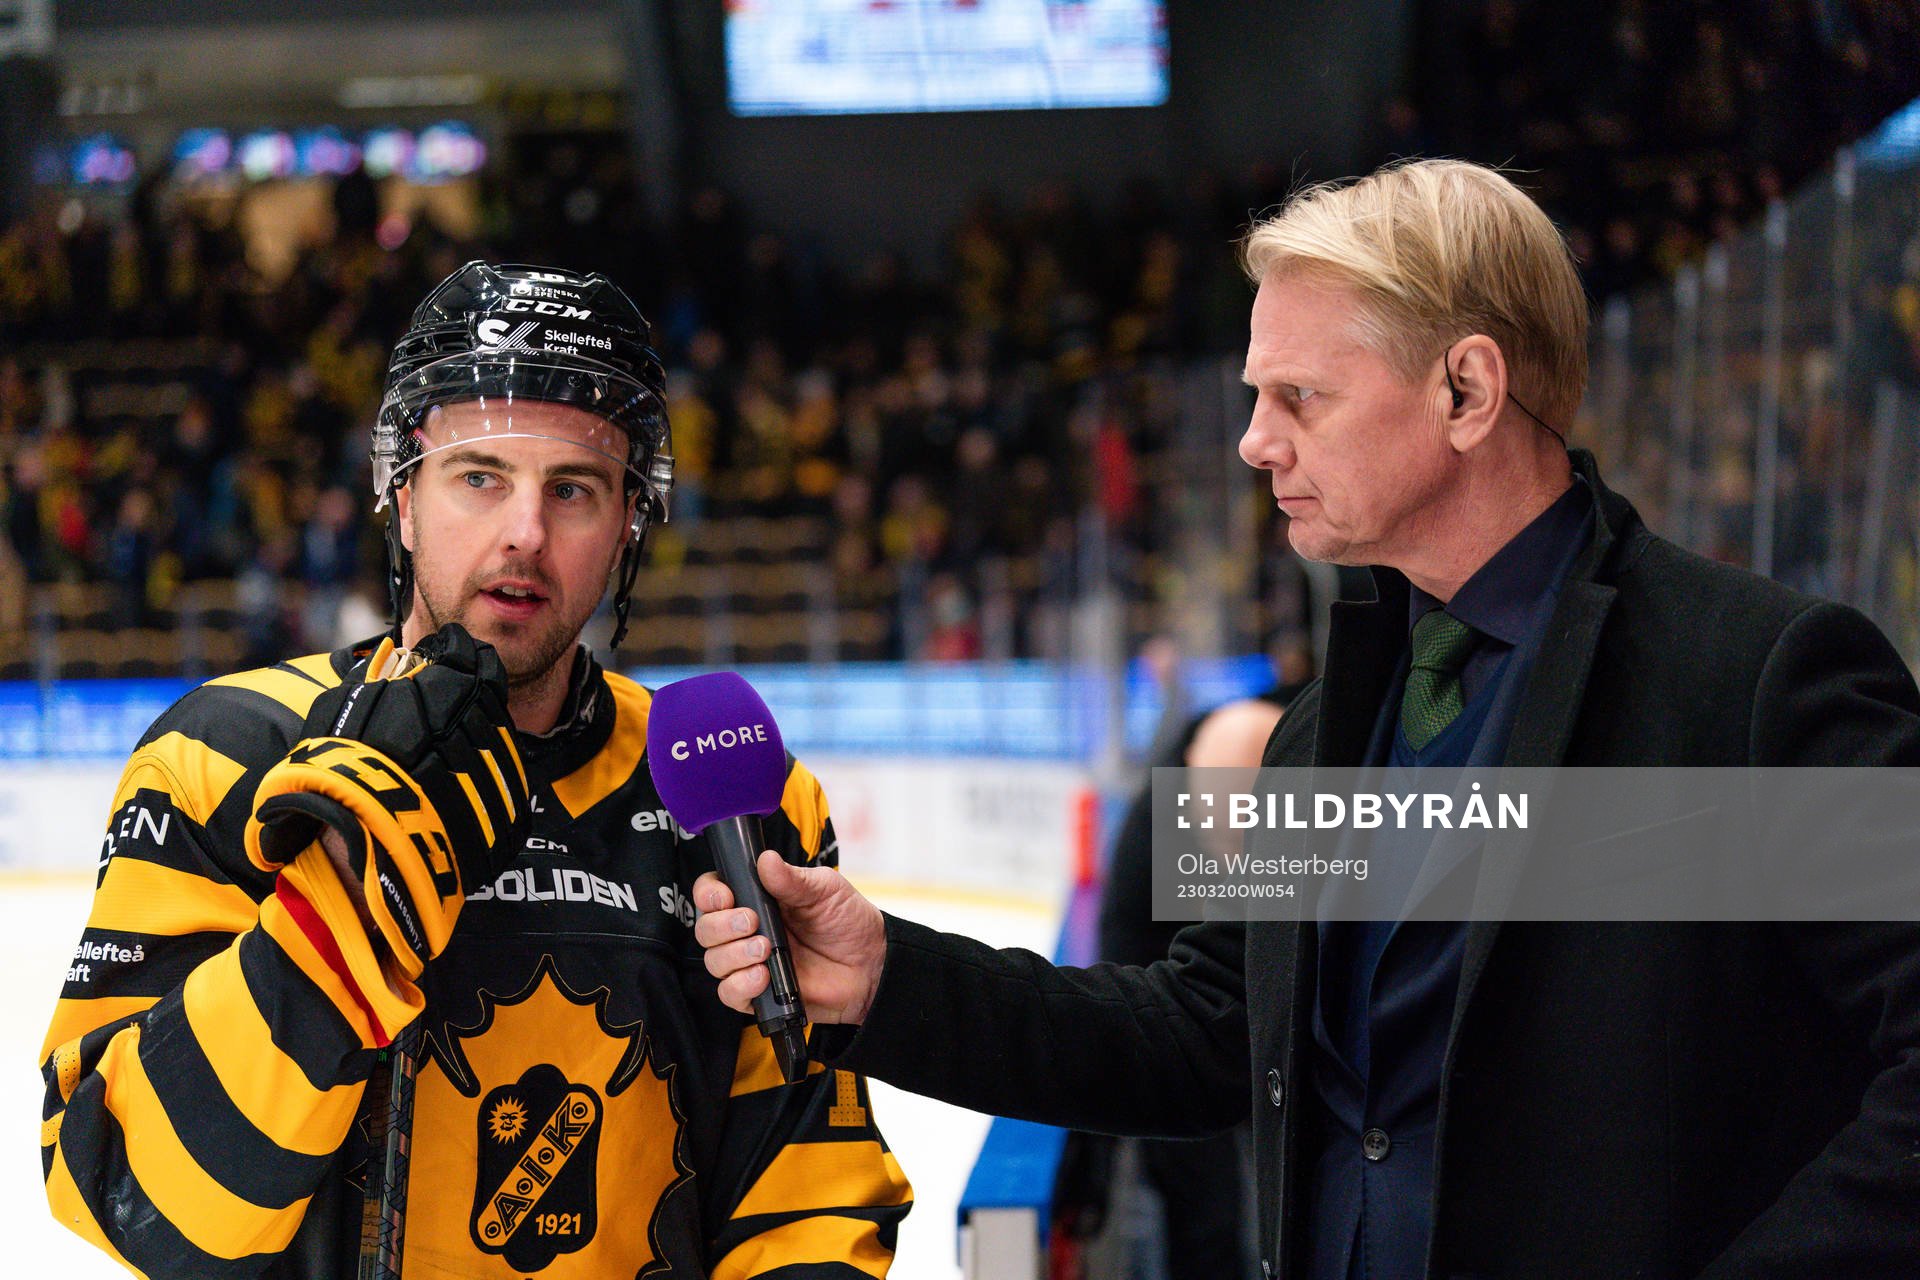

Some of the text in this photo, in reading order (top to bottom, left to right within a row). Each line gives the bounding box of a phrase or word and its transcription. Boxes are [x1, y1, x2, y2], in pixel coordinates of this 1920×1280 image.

[535, 286, 581, 300] SVENSKA
[535, 291, 560, 300] SPEL
[505, 298, 592, 321] CCM
[544, 329, 612, 351] Skellefteå
[671, 724, 768, 761] C MORE
[525, 837, 569, 853] CM
[73, 941, 145, 963] ellefteå
[65, 963, 91, 983] aft
[535, 1212, 581, 1236] 1921
